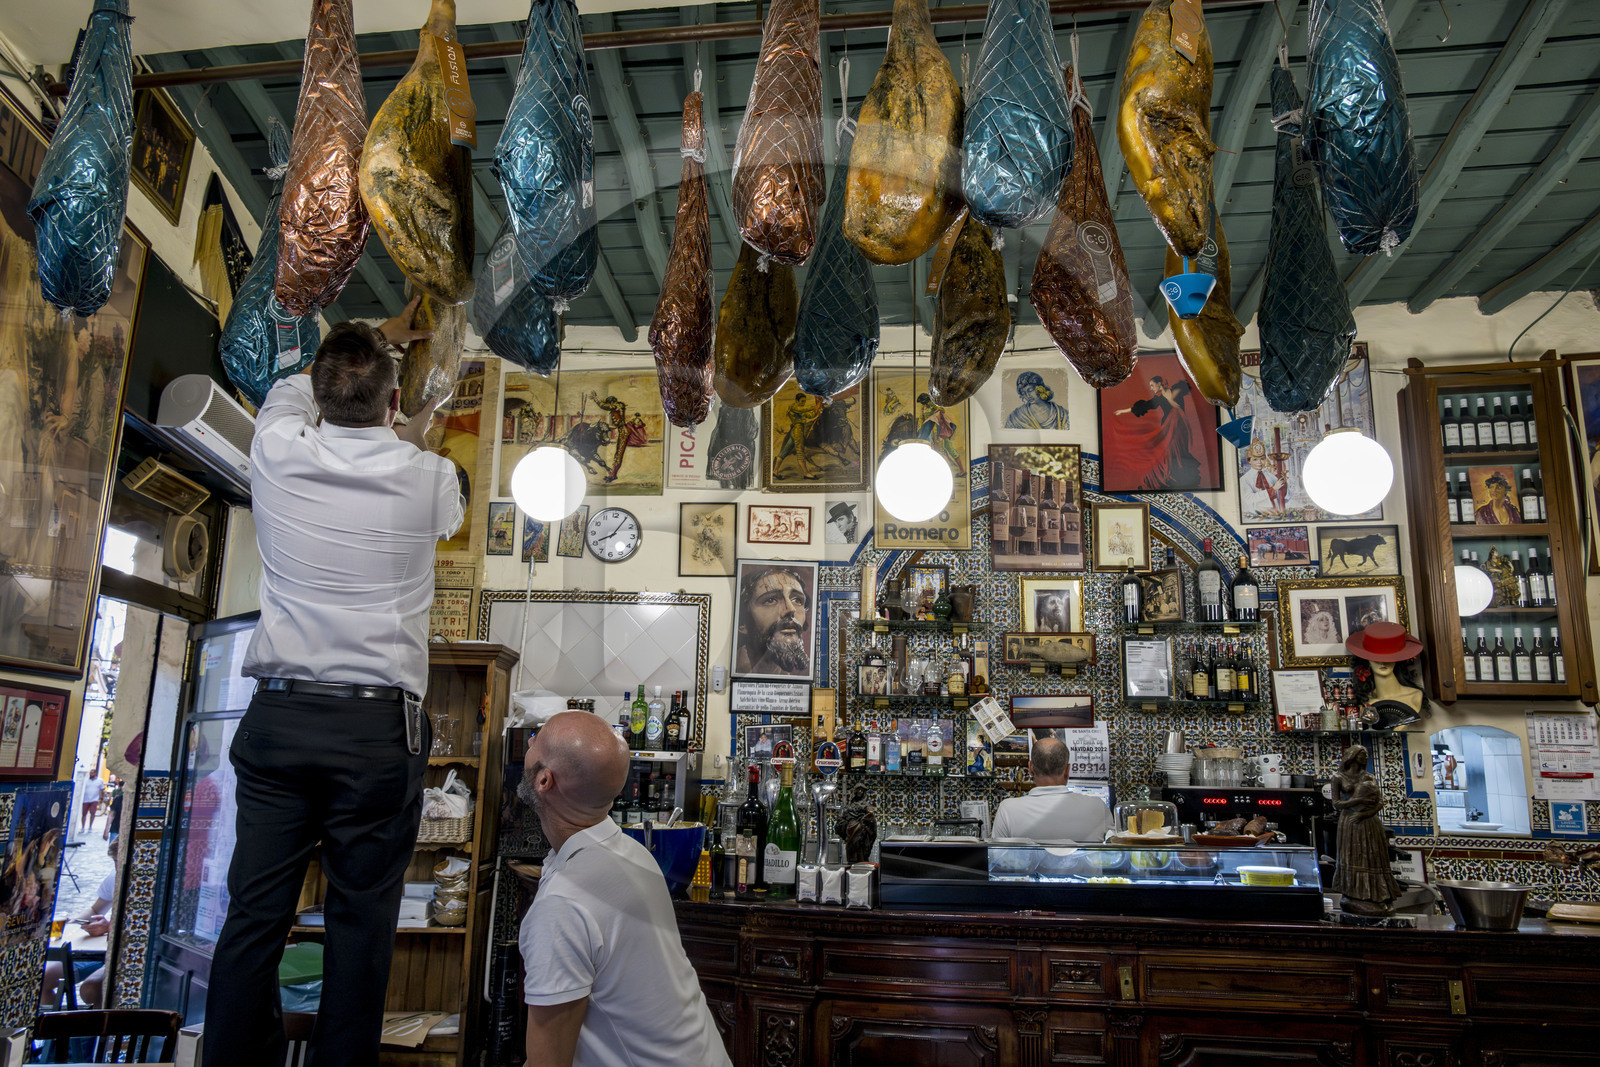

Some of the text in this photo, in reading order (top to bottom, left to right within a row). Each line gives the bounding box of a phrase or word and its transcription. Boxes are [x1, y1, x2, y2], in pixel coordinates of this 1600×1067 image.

[884, 523, 959, 540] Romero
[440, 629, 466, 638] PONCE
[1072, 763, 1106, 771] 89314
